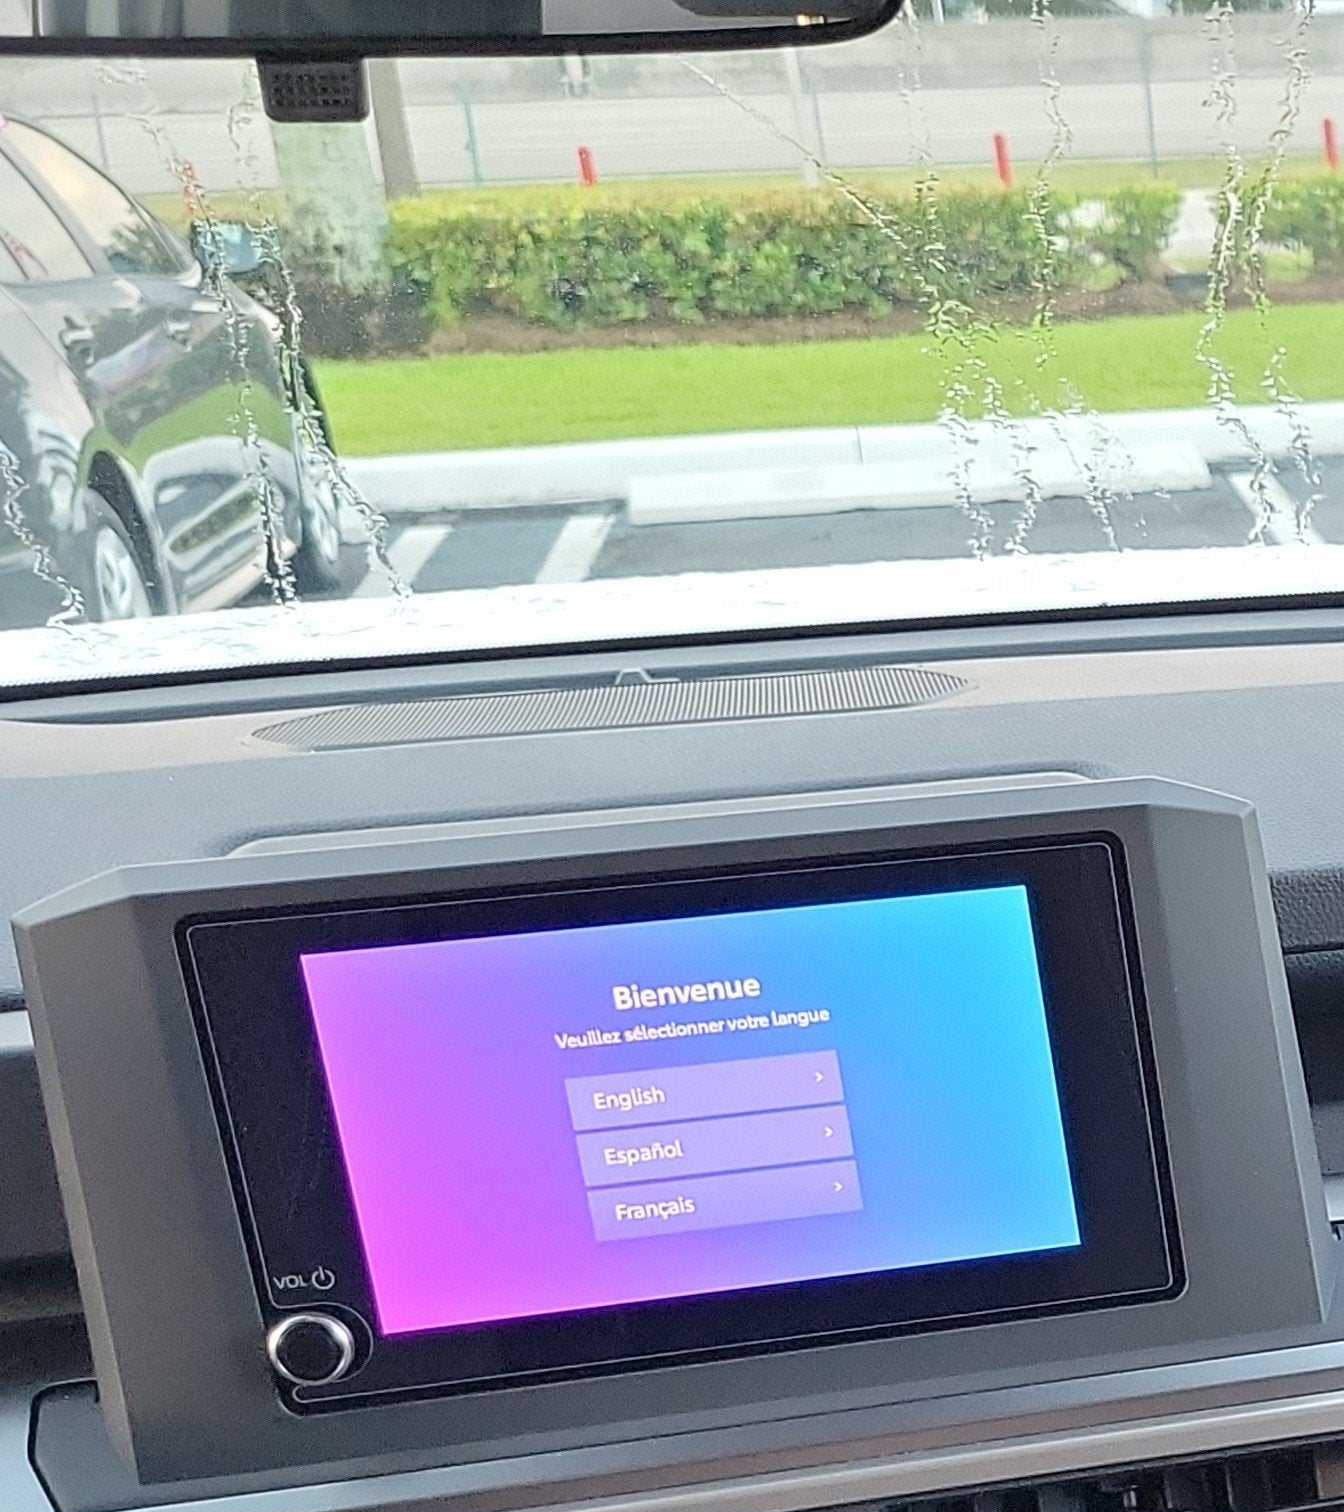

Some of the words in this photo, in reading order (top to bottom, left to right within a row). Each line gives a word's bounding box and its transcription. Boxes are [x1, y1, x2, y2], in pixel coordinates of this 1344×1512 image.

[612, 977, 761, 1010] Bienvenue
[555, 1031, 621, 1050] Veuillez
[624, 1019, 725, 1042] sélectionner
[726, 1014, 770, 1032] votre
[772, 1007, 830, 1028] langue
[593, 1086, 666, 1111] English
[604, 1140, 684, 1167] Español
[615, 1196, 696, 1221] Français
[272, 1274, 307, 1289] VOL
